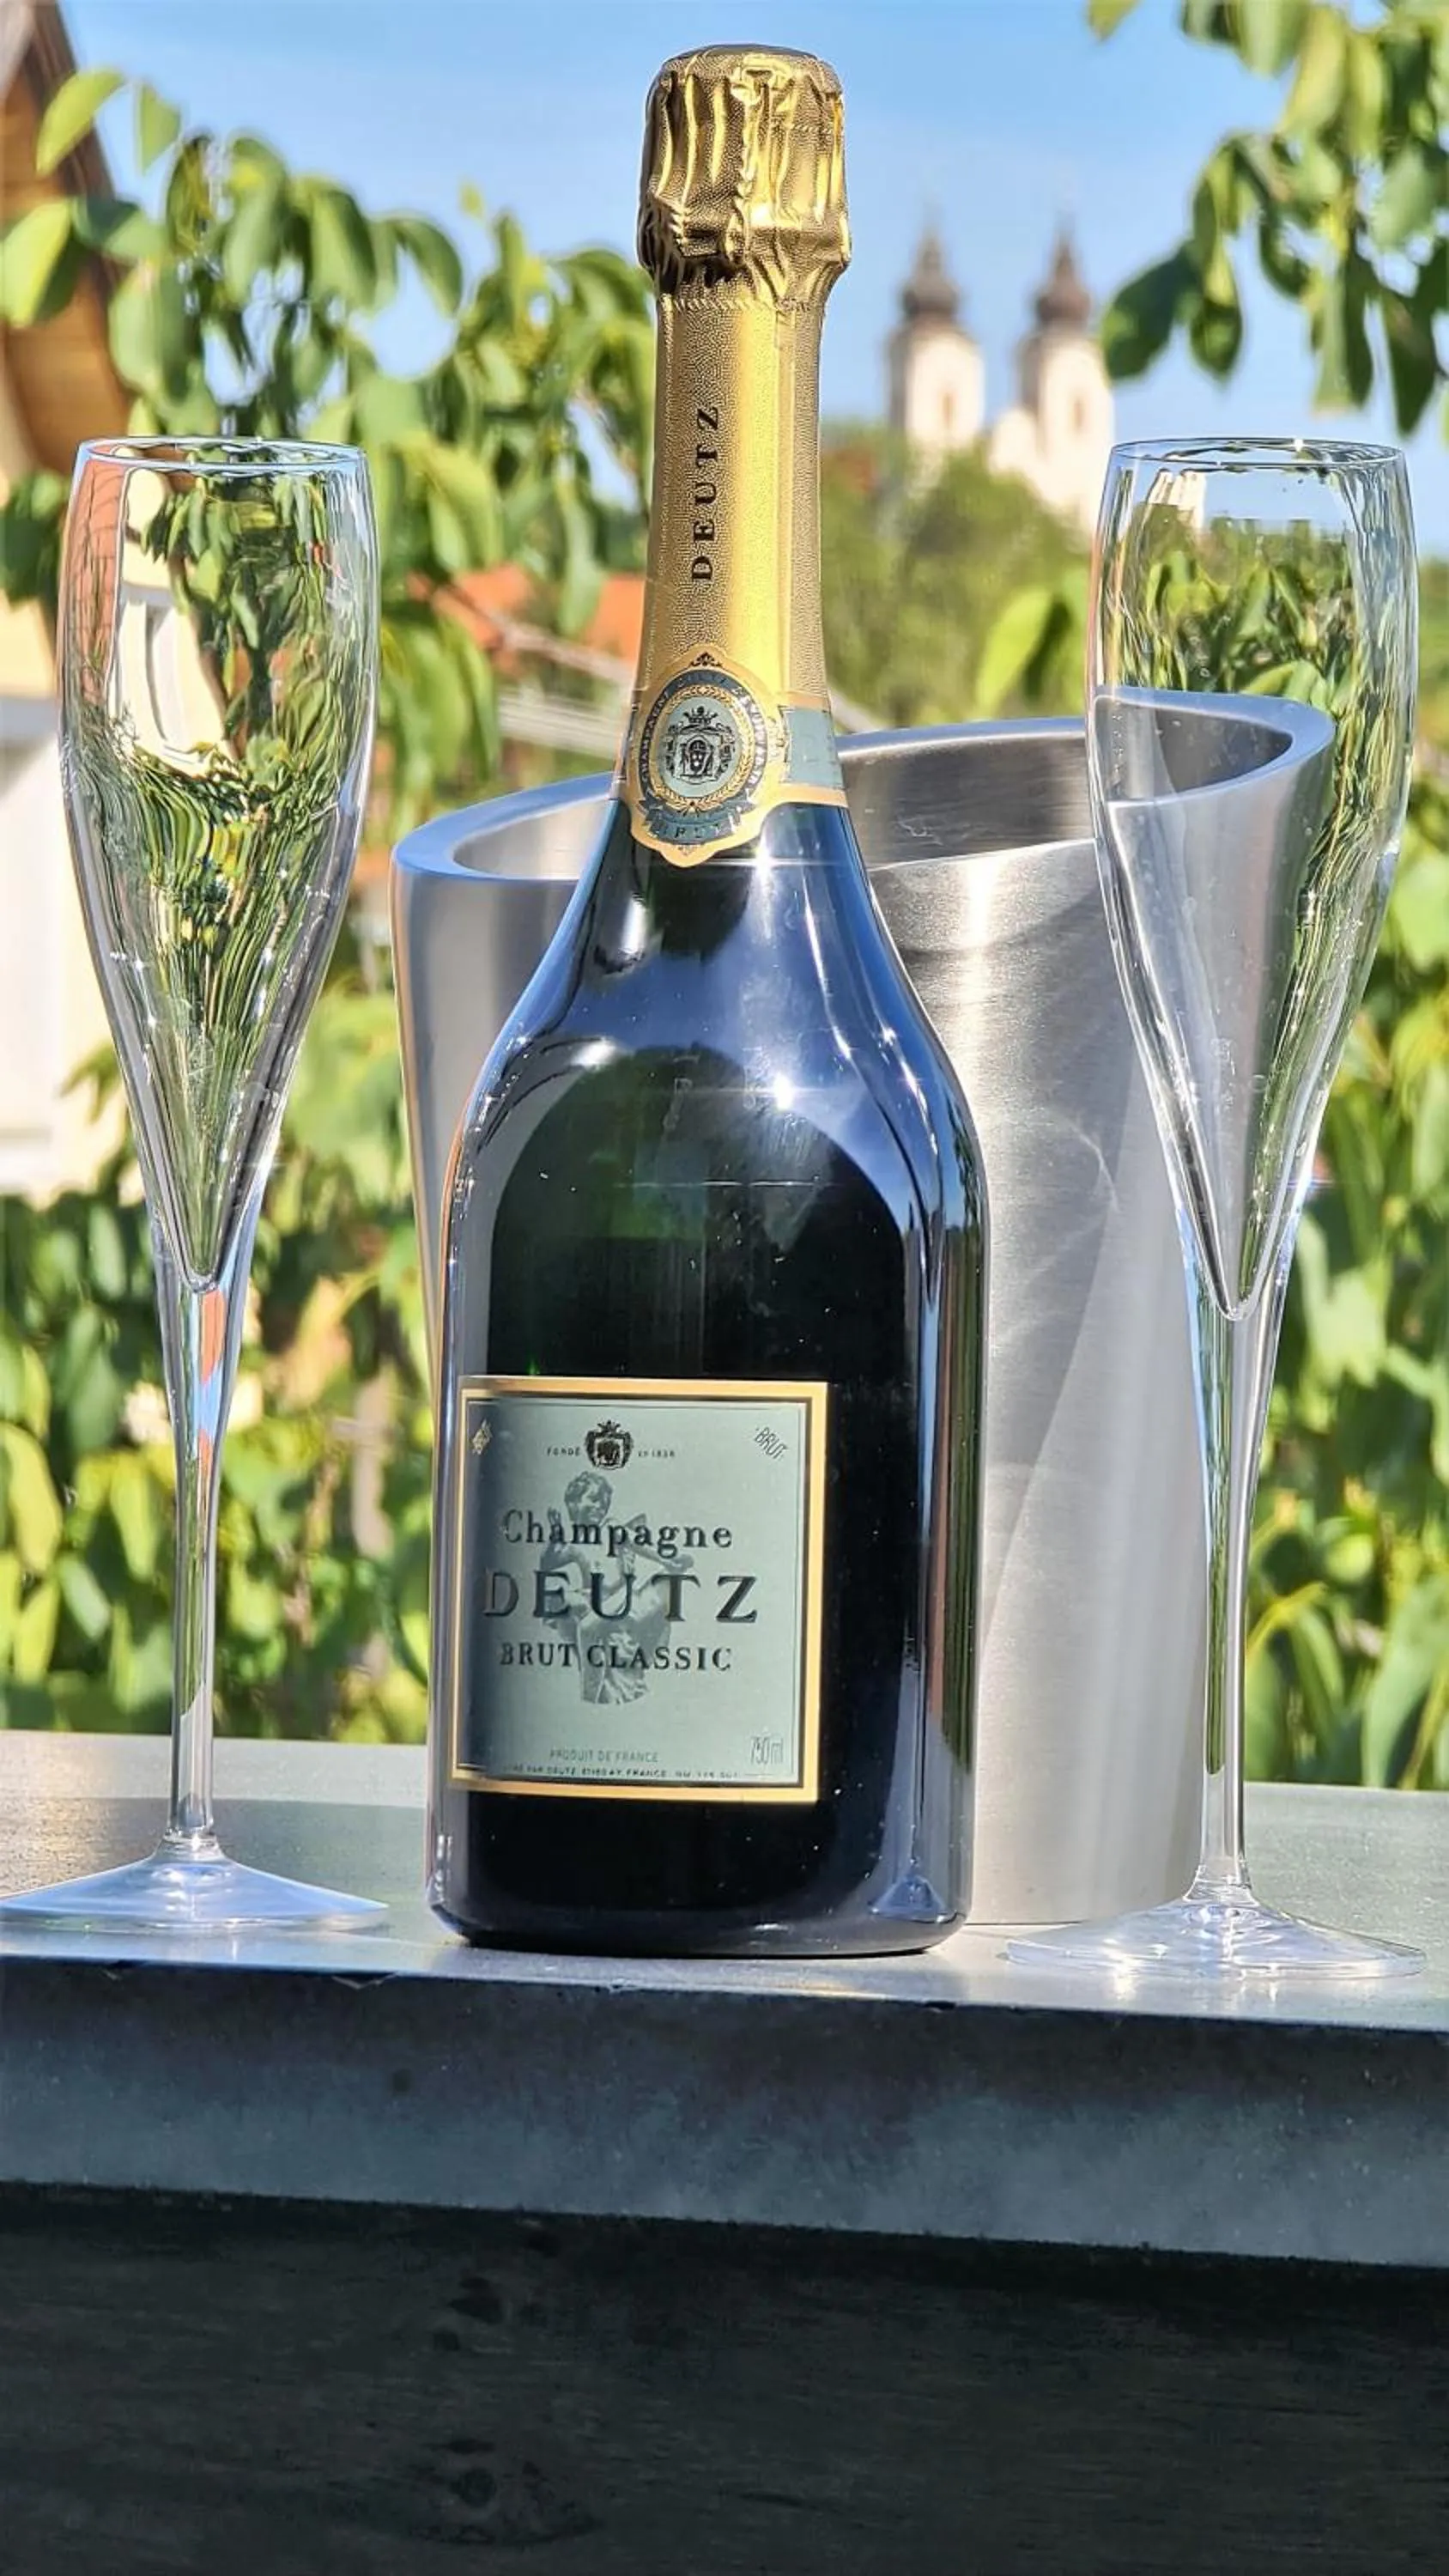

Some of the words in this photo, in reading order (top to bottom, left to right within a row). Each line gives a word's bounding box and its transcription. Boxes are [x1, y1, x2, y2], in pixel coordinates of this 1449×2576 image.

[691, 406, 718, 581] DEUTZ
[755, 1426, 788, 1461] BRUT
[503, 1509, 733, 1558] Champagne
[482, 1570, 758, 1624] DEUTZ
[500, 1642, 577, 1668] BRUT
[587, 1643, 732, 1672] CLASSIC
[549, 1748, 593, 1762] PRODUIT
[597, 1749, 612, 1762] DE
[615, 1750, 659, 1764] FRANCE
[626, 1767, 667, 1778] FRANCE
